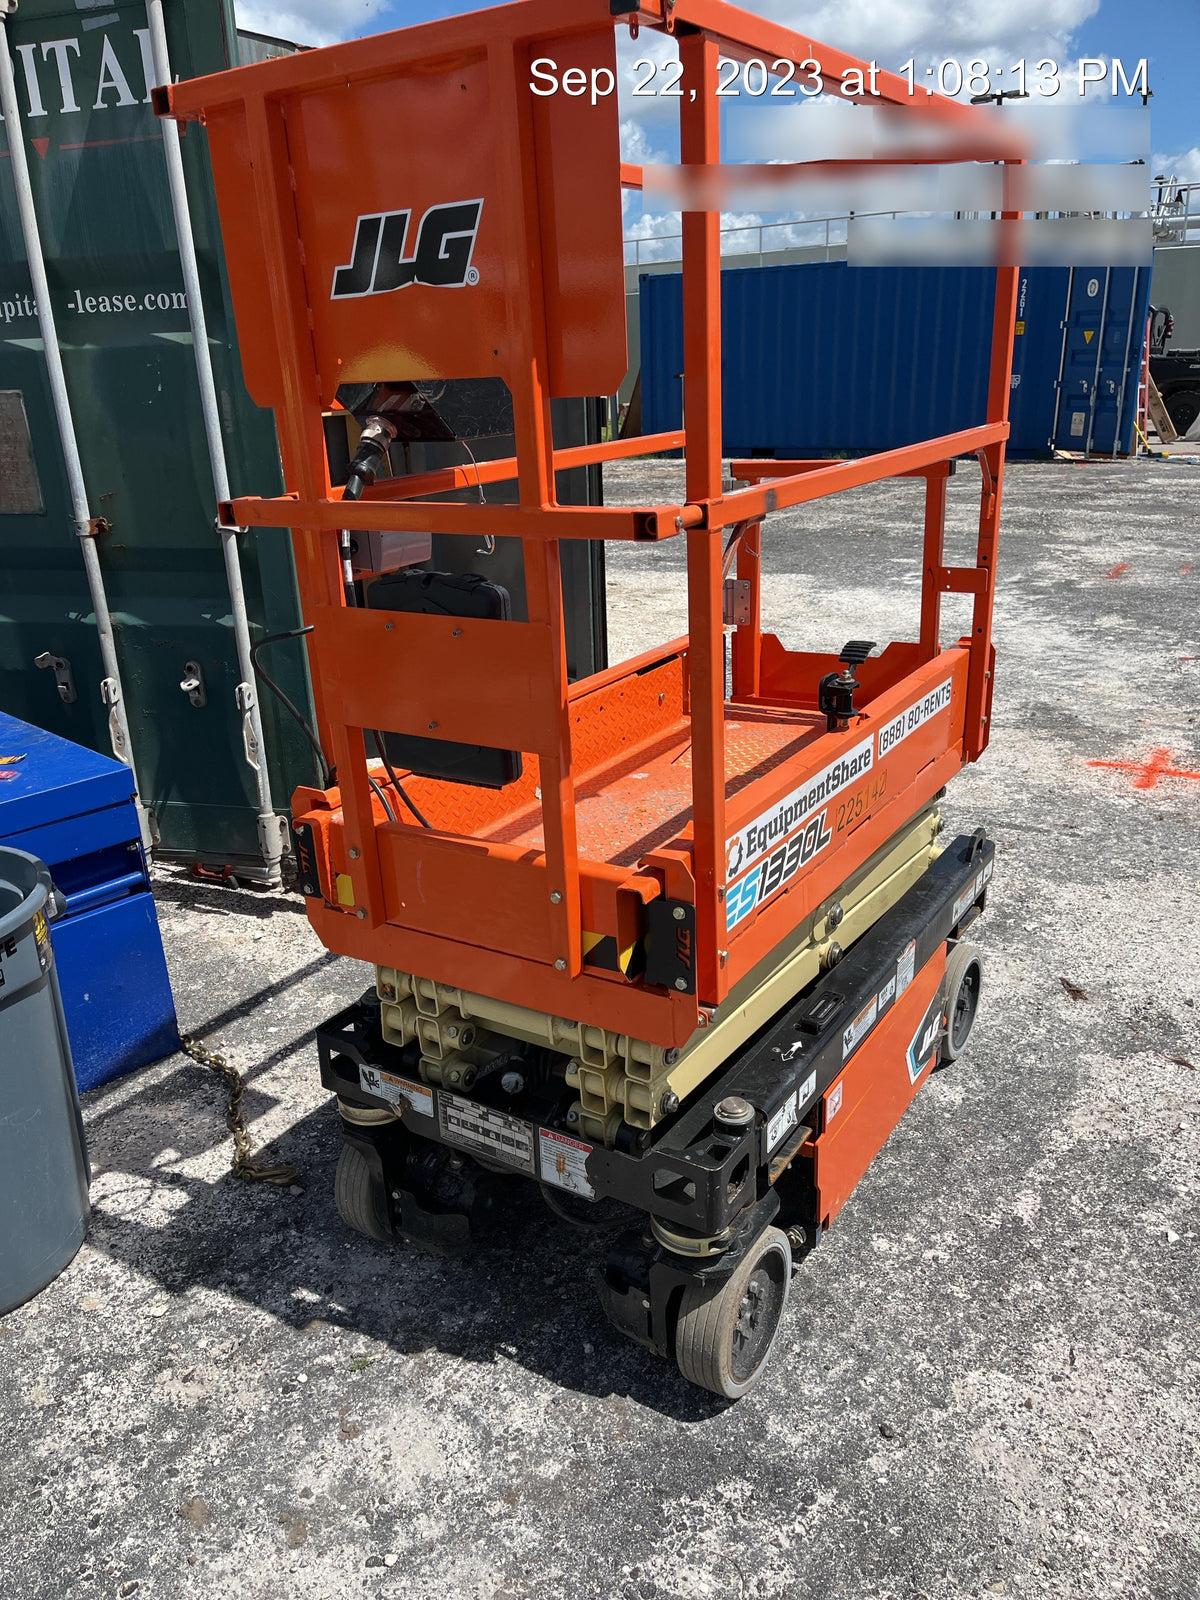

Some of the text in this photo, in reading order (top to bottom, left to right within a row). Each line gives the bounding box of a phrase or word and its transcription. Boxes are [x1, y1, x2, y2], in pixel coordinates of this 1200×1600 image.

[745, 746, 871, 859] EquipmentShare
[727, 811, 831, 930] ES1330L
[676, 927, 691, 970] JLG
